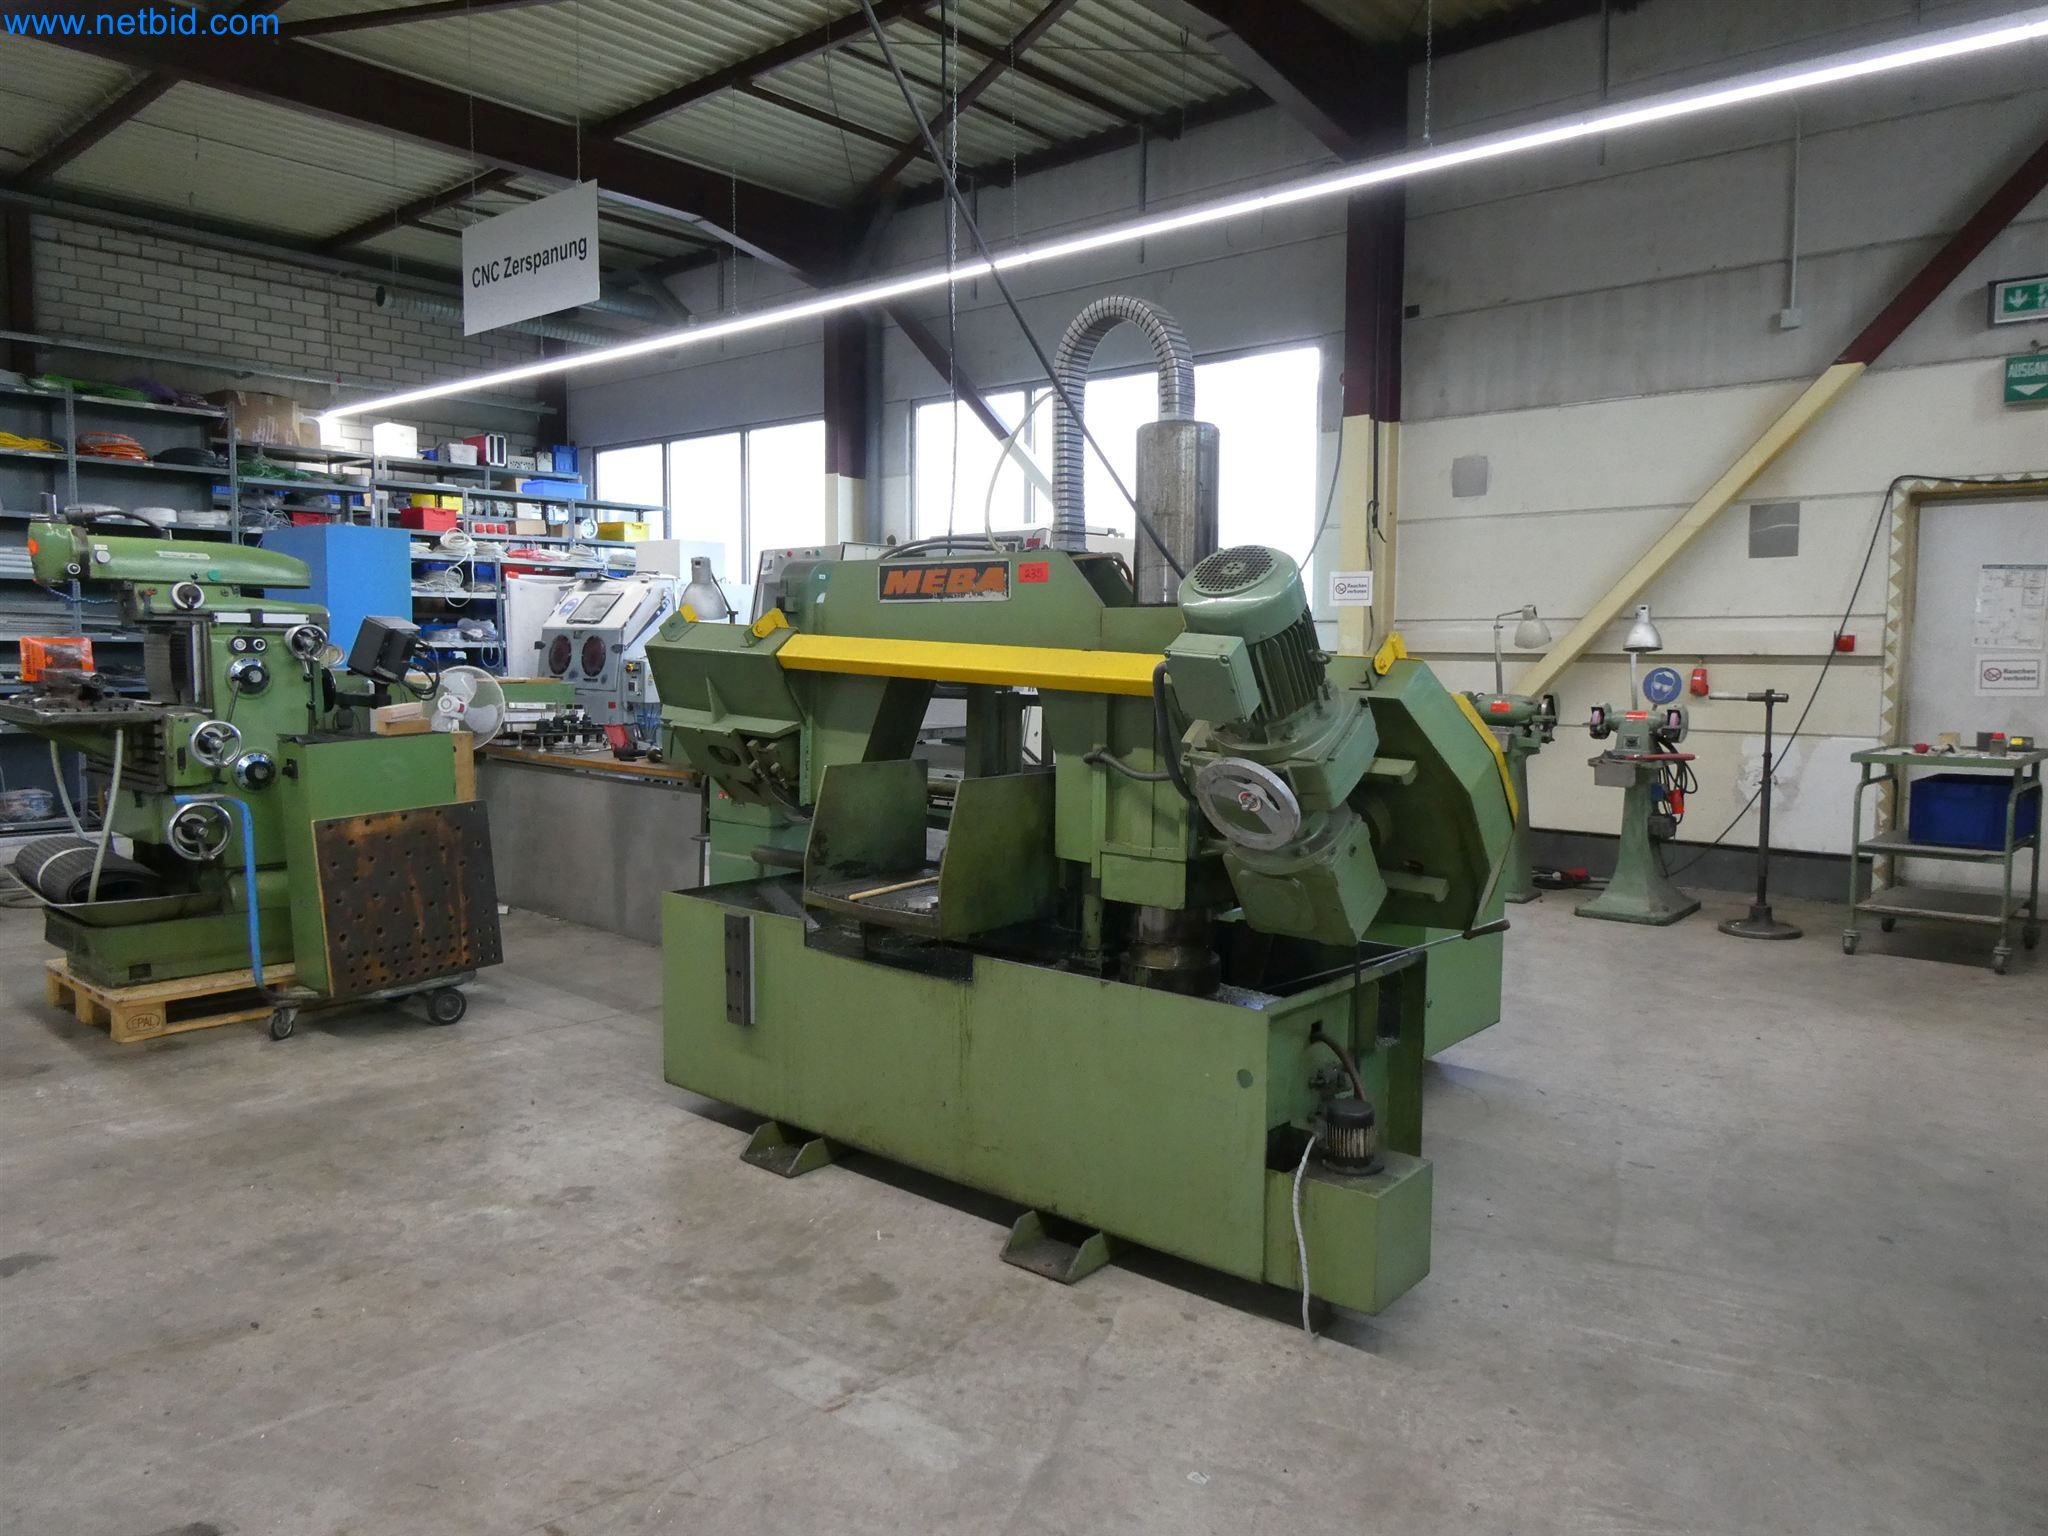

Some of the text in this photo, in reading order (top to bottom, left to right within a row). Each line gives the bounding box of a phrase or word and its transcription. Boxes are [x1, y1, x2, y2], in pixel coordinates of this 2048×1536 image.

[472, 237, 587, 288] CNC Zerspanung
[883, 567, 1005, 595] MEBA
